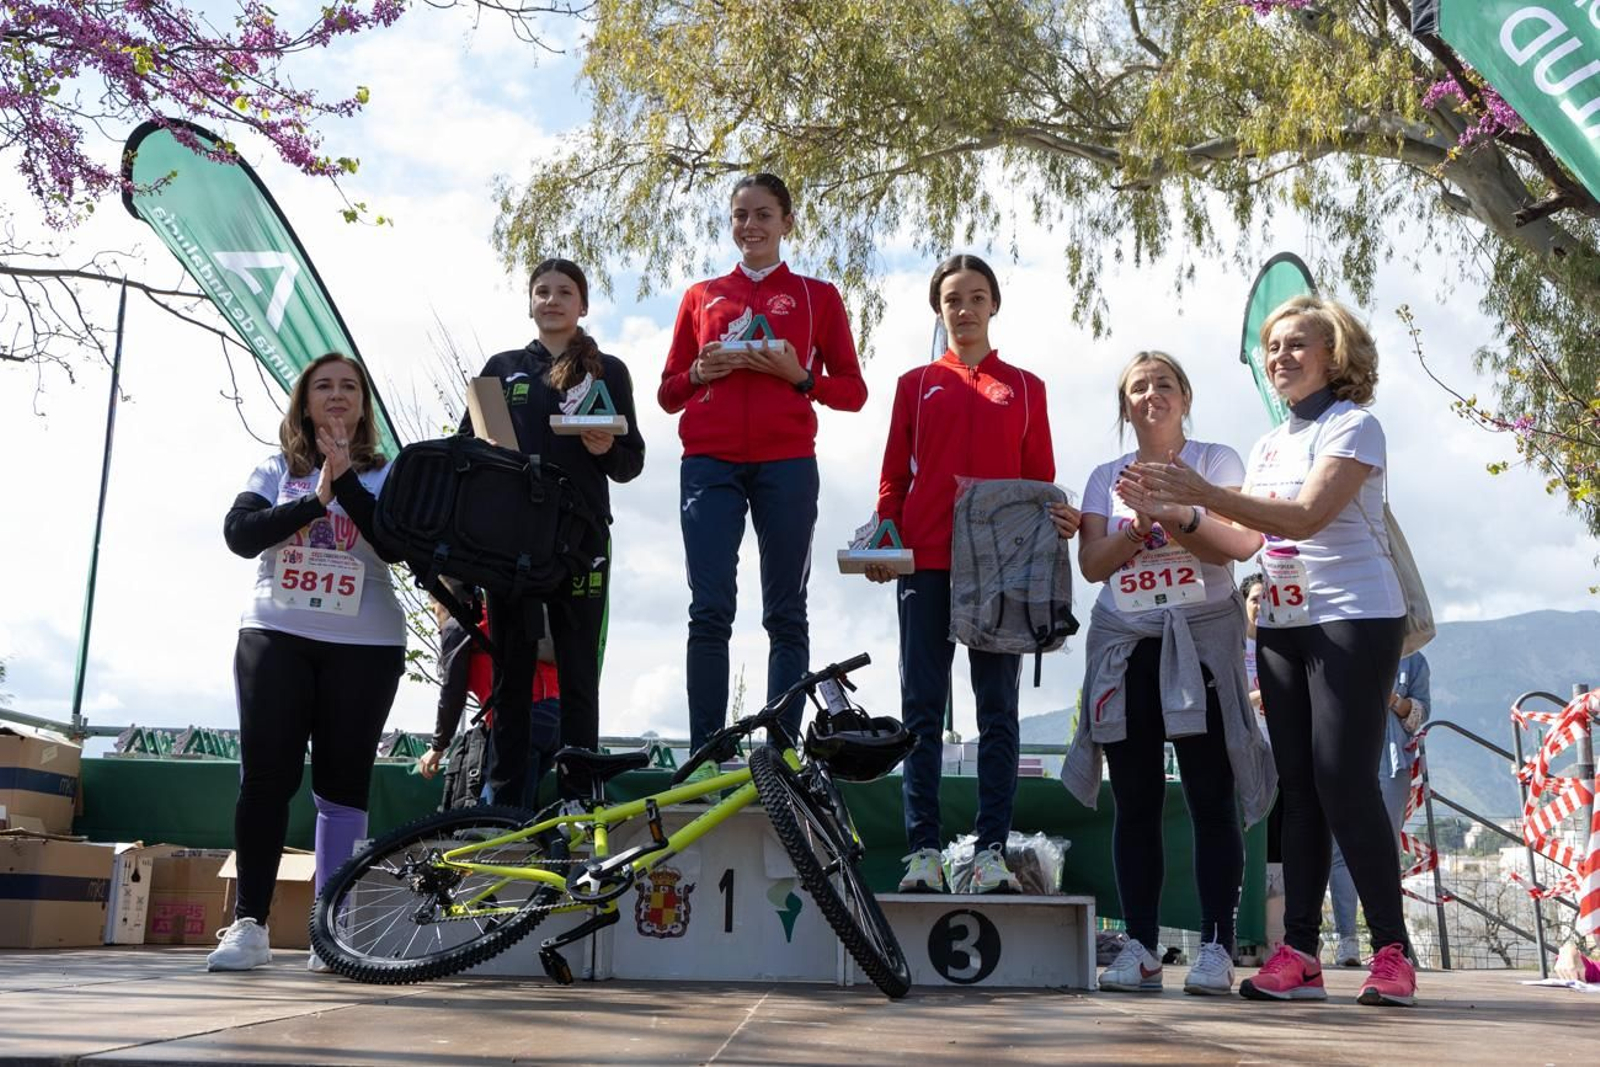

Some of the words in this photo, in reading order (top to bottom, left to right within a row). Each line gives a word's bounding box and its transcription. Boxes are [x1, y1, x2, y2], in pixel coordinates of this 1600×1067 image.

[281, 568, 356, 596] 5815
[1120, 567, 1196, 593] 5812
[1263, 584, 1304, 607] 13
[718, 868, 734, 933] 1
[946, 913, 983, 979] 3
